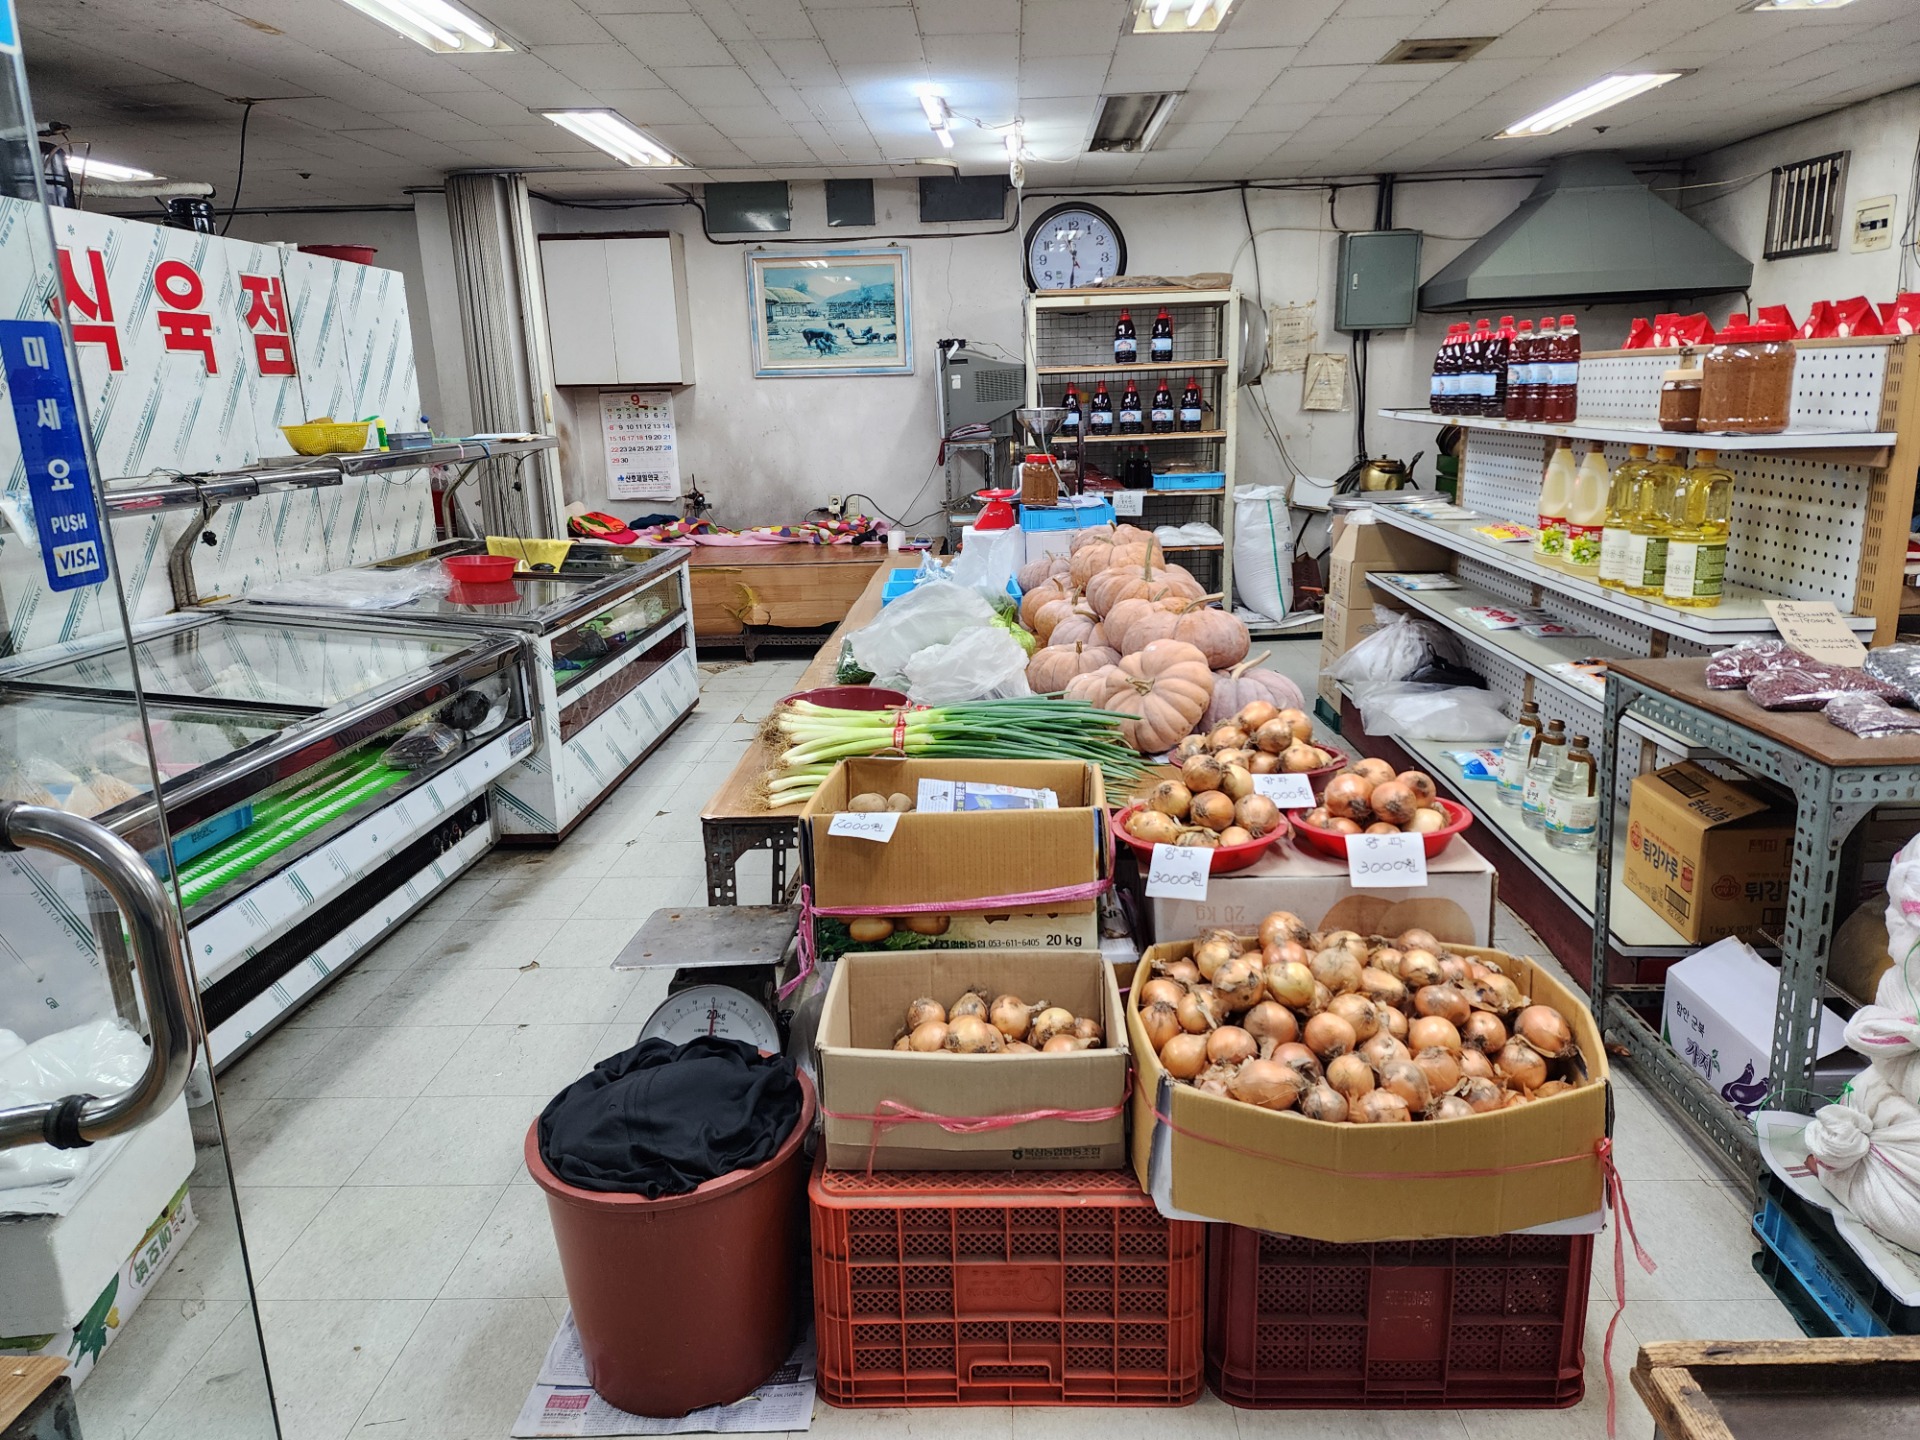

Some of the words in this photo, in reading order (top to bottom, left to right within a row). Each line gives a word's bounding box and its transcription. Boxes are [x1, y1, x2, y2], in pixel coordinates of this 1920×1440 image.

[1069, 221, 1079, 230] 12
[1087, 225, 1091, 234] 1
[1096, 235, 1104, 246] 2
[1039, 255, 1047, 265] 9
[1101, 252, 1109, 263] 3
[1044, 271, 1052, 280] 8
[1096, 267, 1103, 277] 4
[631, 394, 640, 405] 9
[21, 337, 75, 491] 미세요
[51, 512, 88, 535] PUSH
[59, 546, 98, 570] VISA
[1356, 858, 1420, 874] 3000원
[1643, 838, 1679, 882] 튀김가루
[1150, 871, 1204, 887] 3000원
[1223, 905, 1245, 922] 20
[988, 938, 1040, 947] 053-611-6405
[1046, 934, 1062, 946] 20
[1065, 934, 1082, 947] kg
[706, 1009, 726, 1020] 20kg
[1676, 1001, 1690, 1023] 함안
[1691, 1015, 1706, 1039] 군북
[1685, 1037, 1713, 1081] 가지
